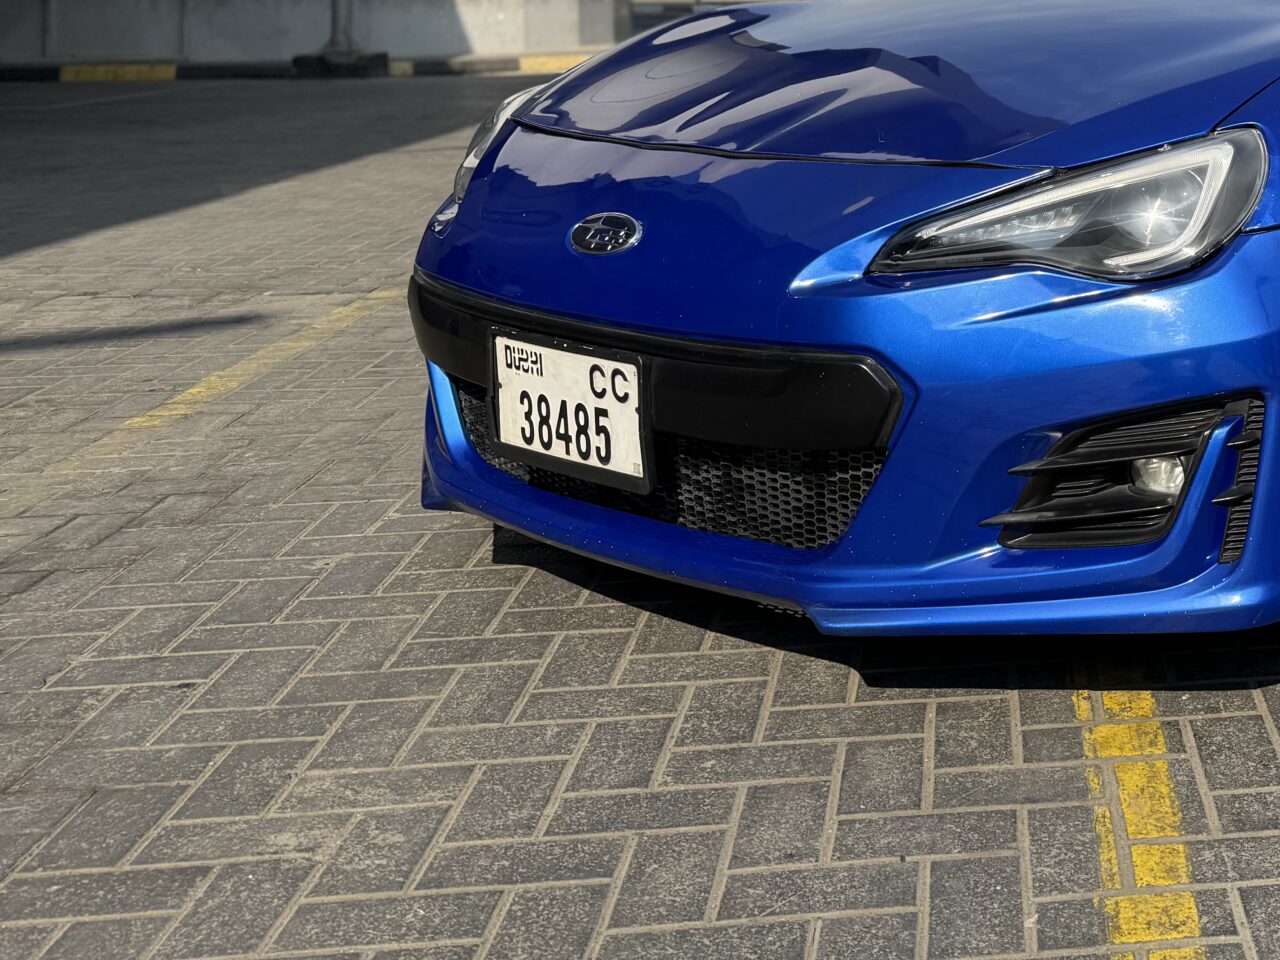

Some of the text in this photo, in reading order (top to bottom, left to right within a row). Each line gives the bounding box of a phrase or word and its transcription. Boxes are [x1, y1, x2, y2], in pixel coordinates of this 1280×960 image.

[504, 344, 544, 377] DUBAI
[589, 363, 630, 404] CC
[519, 390, 612, 466] 38485
